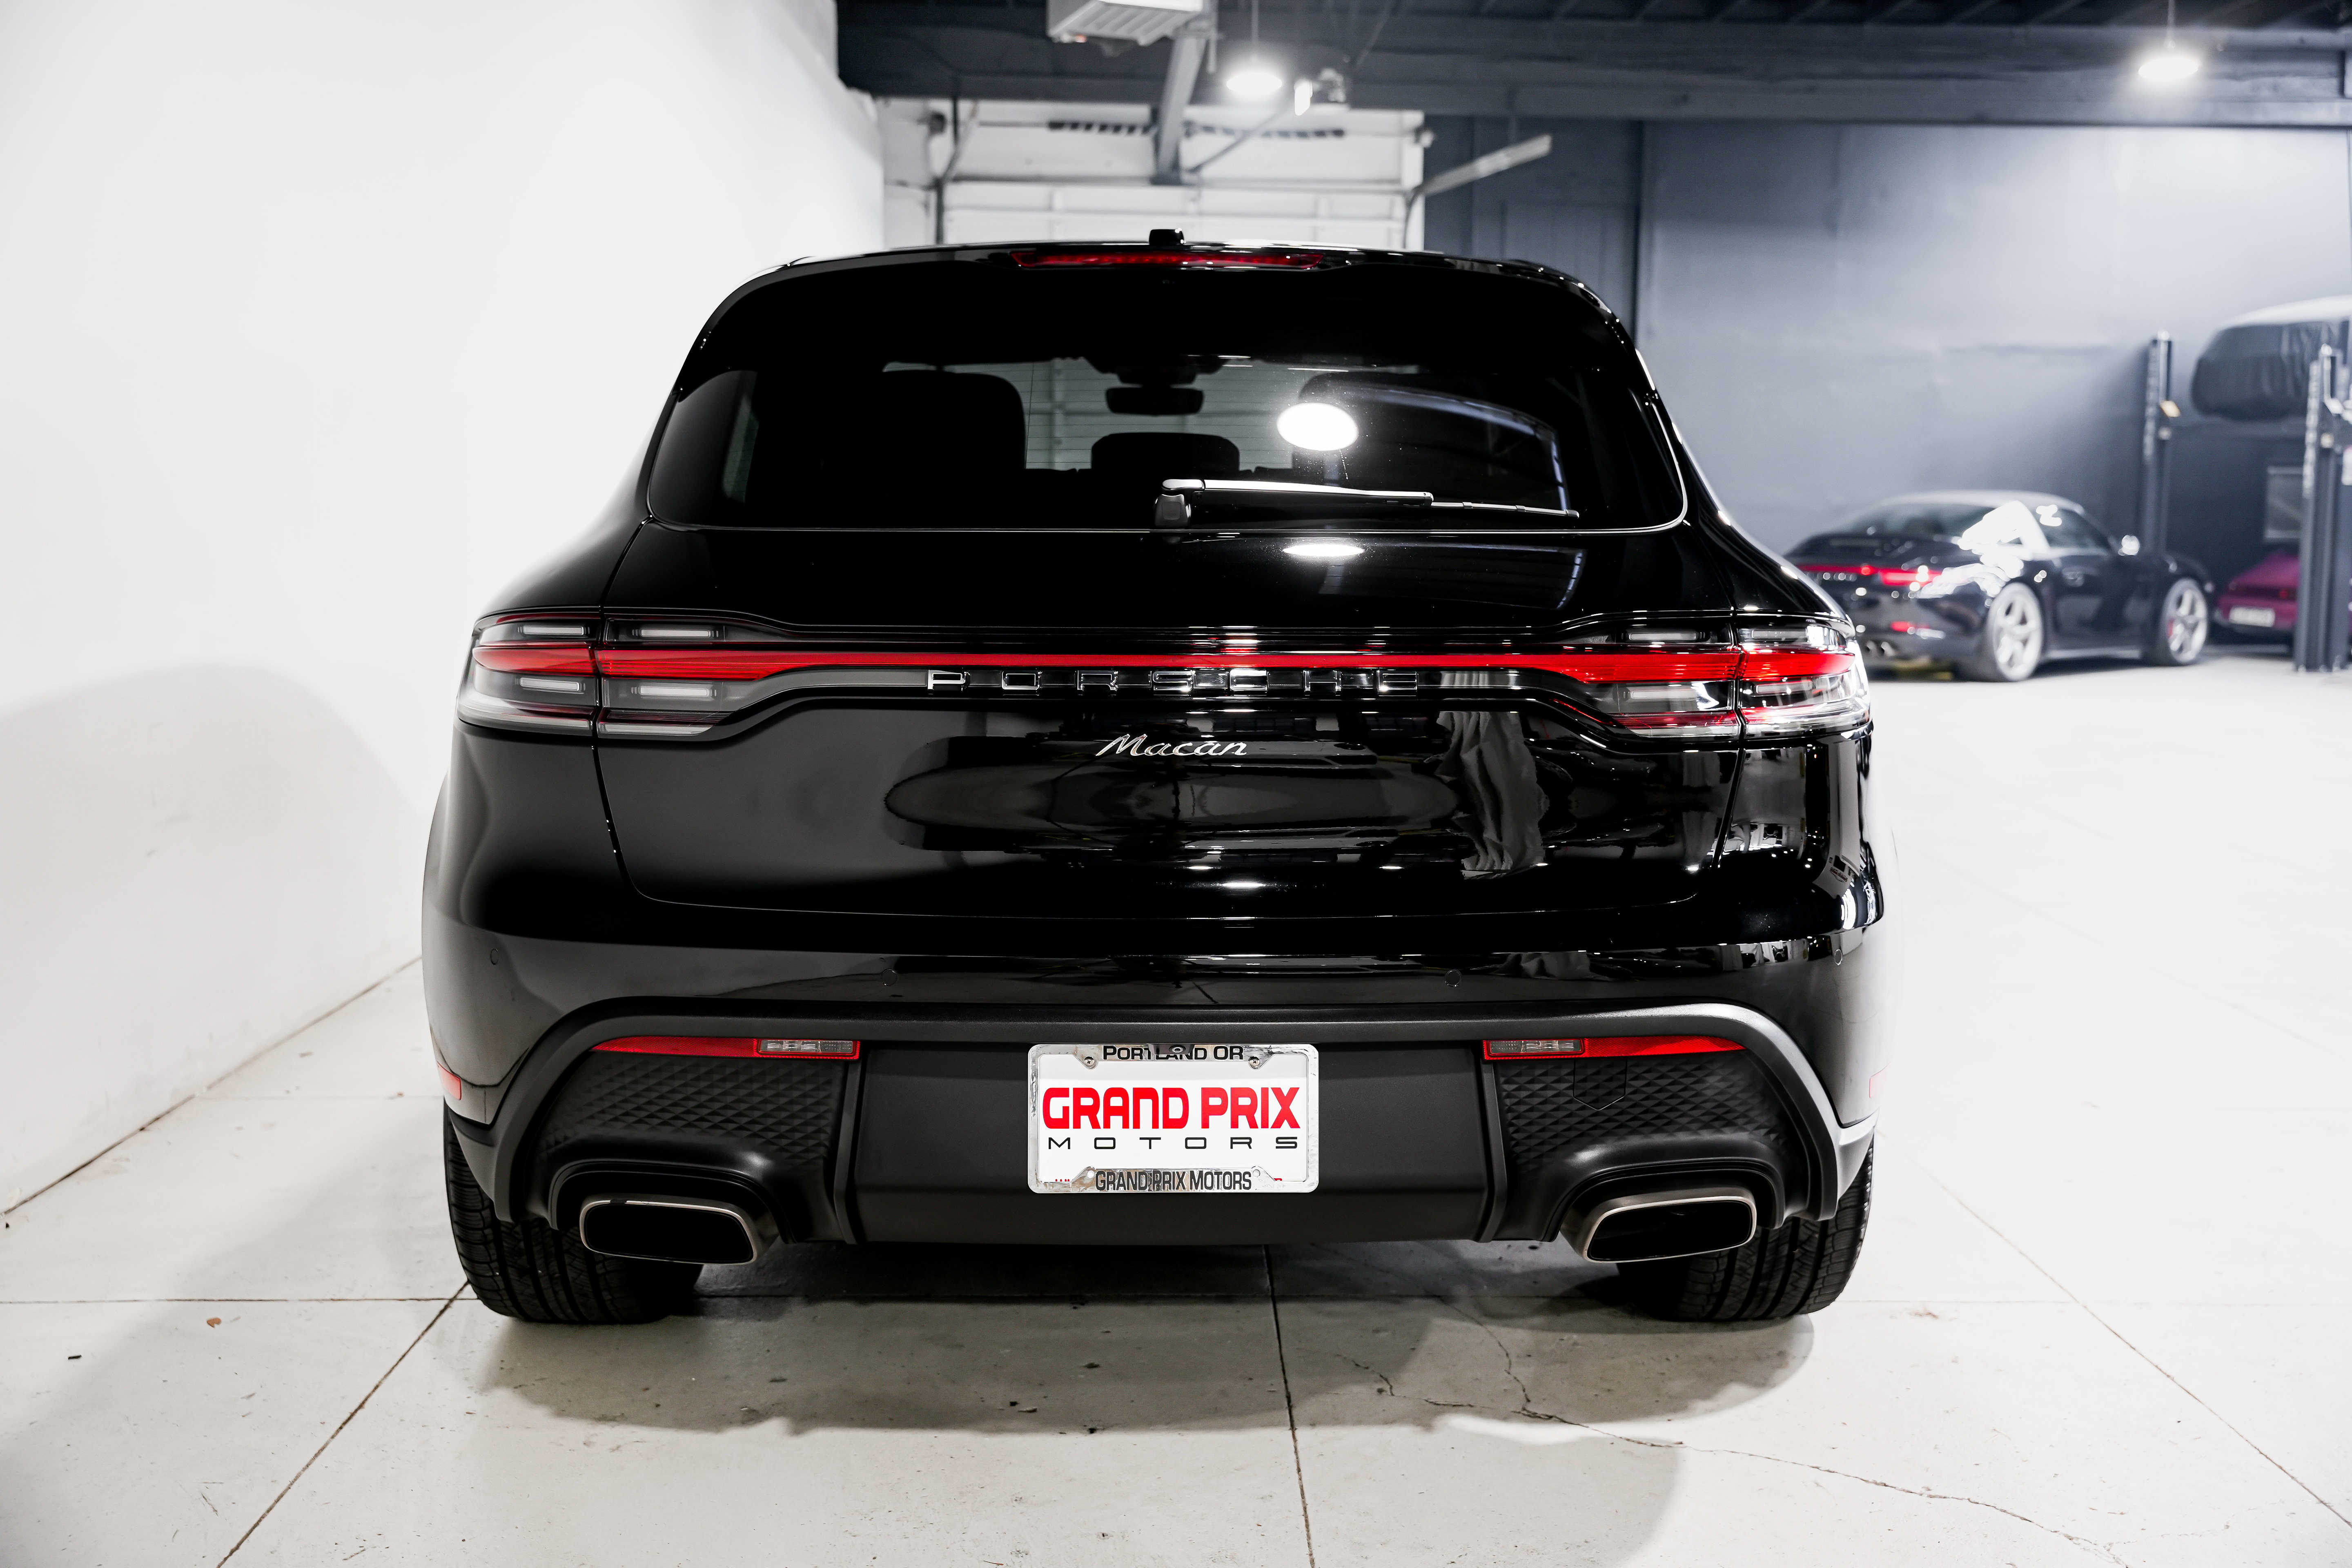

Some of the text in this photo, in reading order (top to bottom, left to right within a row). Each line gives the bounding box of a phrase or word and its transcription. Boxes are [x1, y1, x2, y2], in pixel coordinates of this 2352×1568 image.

[927, 669, 1417, 692] PORSCHE
[1096, 734, 1247, 756] Macan
[1213, 1045, 1244, 1060] OR
[1042, 1087, 1301, 1129] GRAND PRIX
[1048, 1137, 1298, 1149] MOTORS
[1095, 1170, 1252, 1191] GRAND PRIX MOTORS
